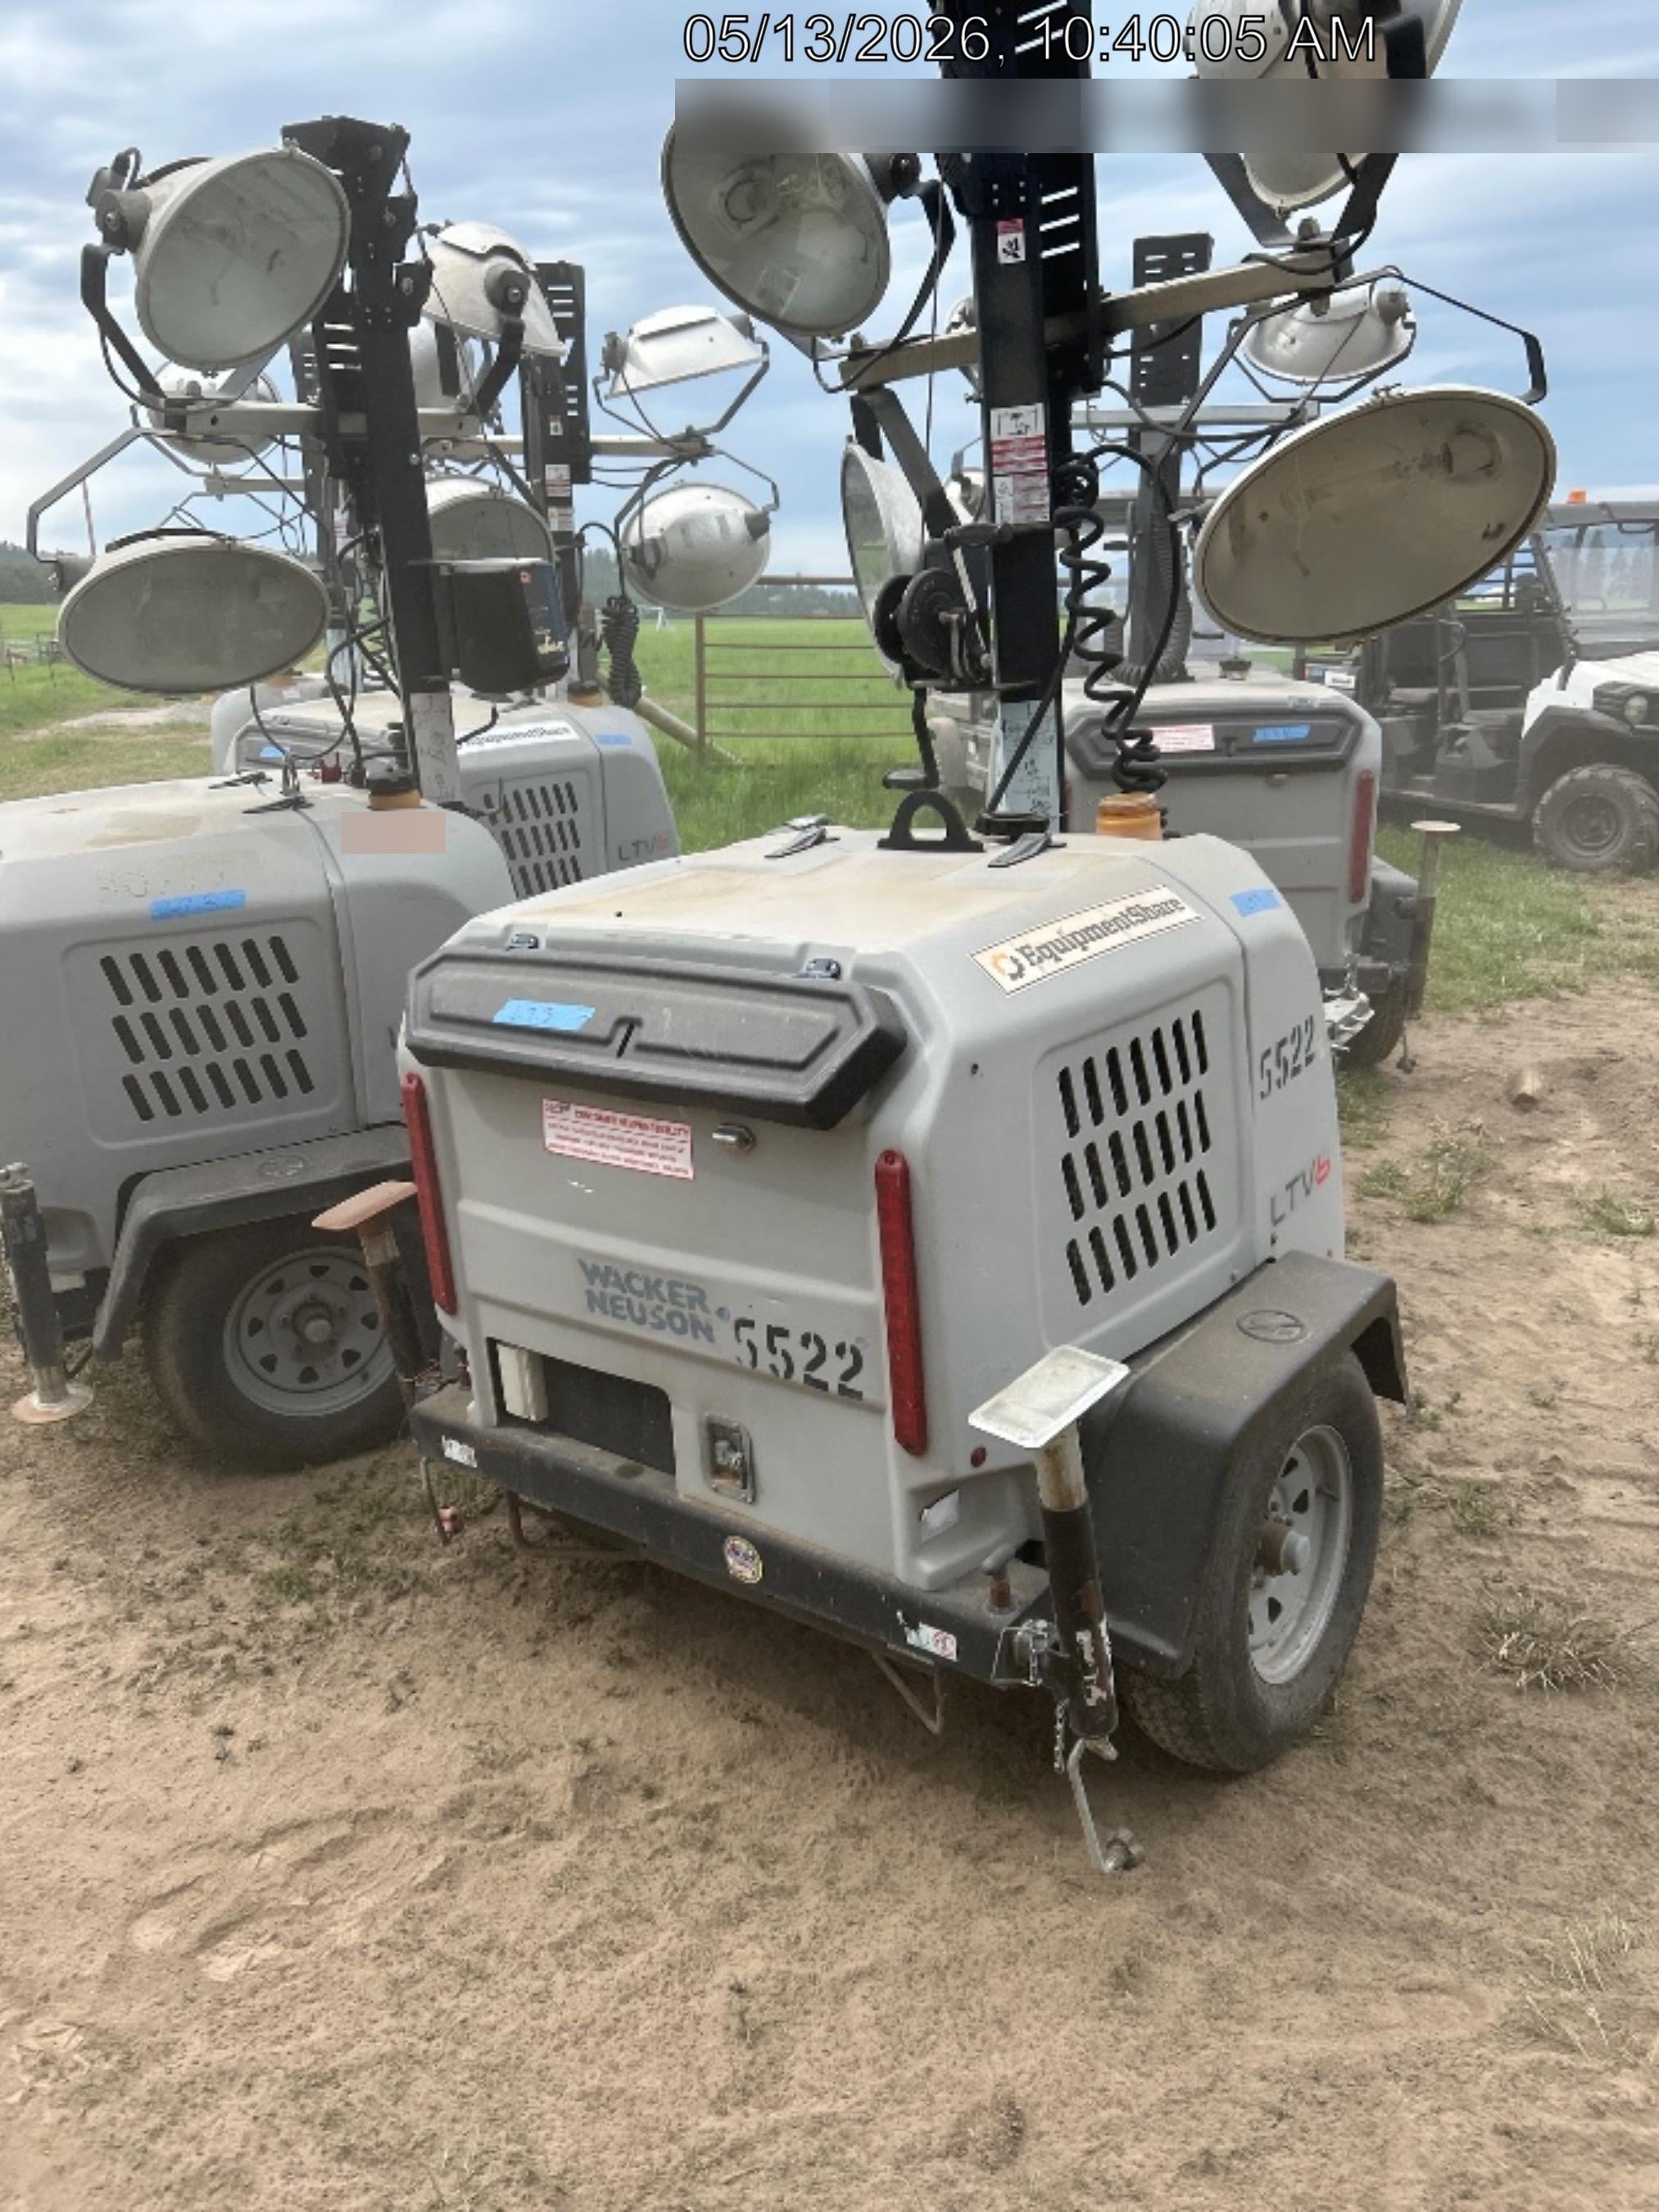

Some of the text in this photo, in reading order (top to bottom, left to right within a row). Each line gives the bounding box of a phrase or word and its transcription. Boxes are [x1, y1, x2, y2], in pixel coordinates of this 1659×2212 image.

[1016, 899, 1185, 967] EquipmentShare
[1260, 1014, 1315, 1100] 5522
[1271, 1154, 1330, 1226] LTV6
[577, 1258, 710, 1314] WACKER
[584, 1289, 716, 1344] NEUSON
[734, 1317, 863, 1400] 5522
